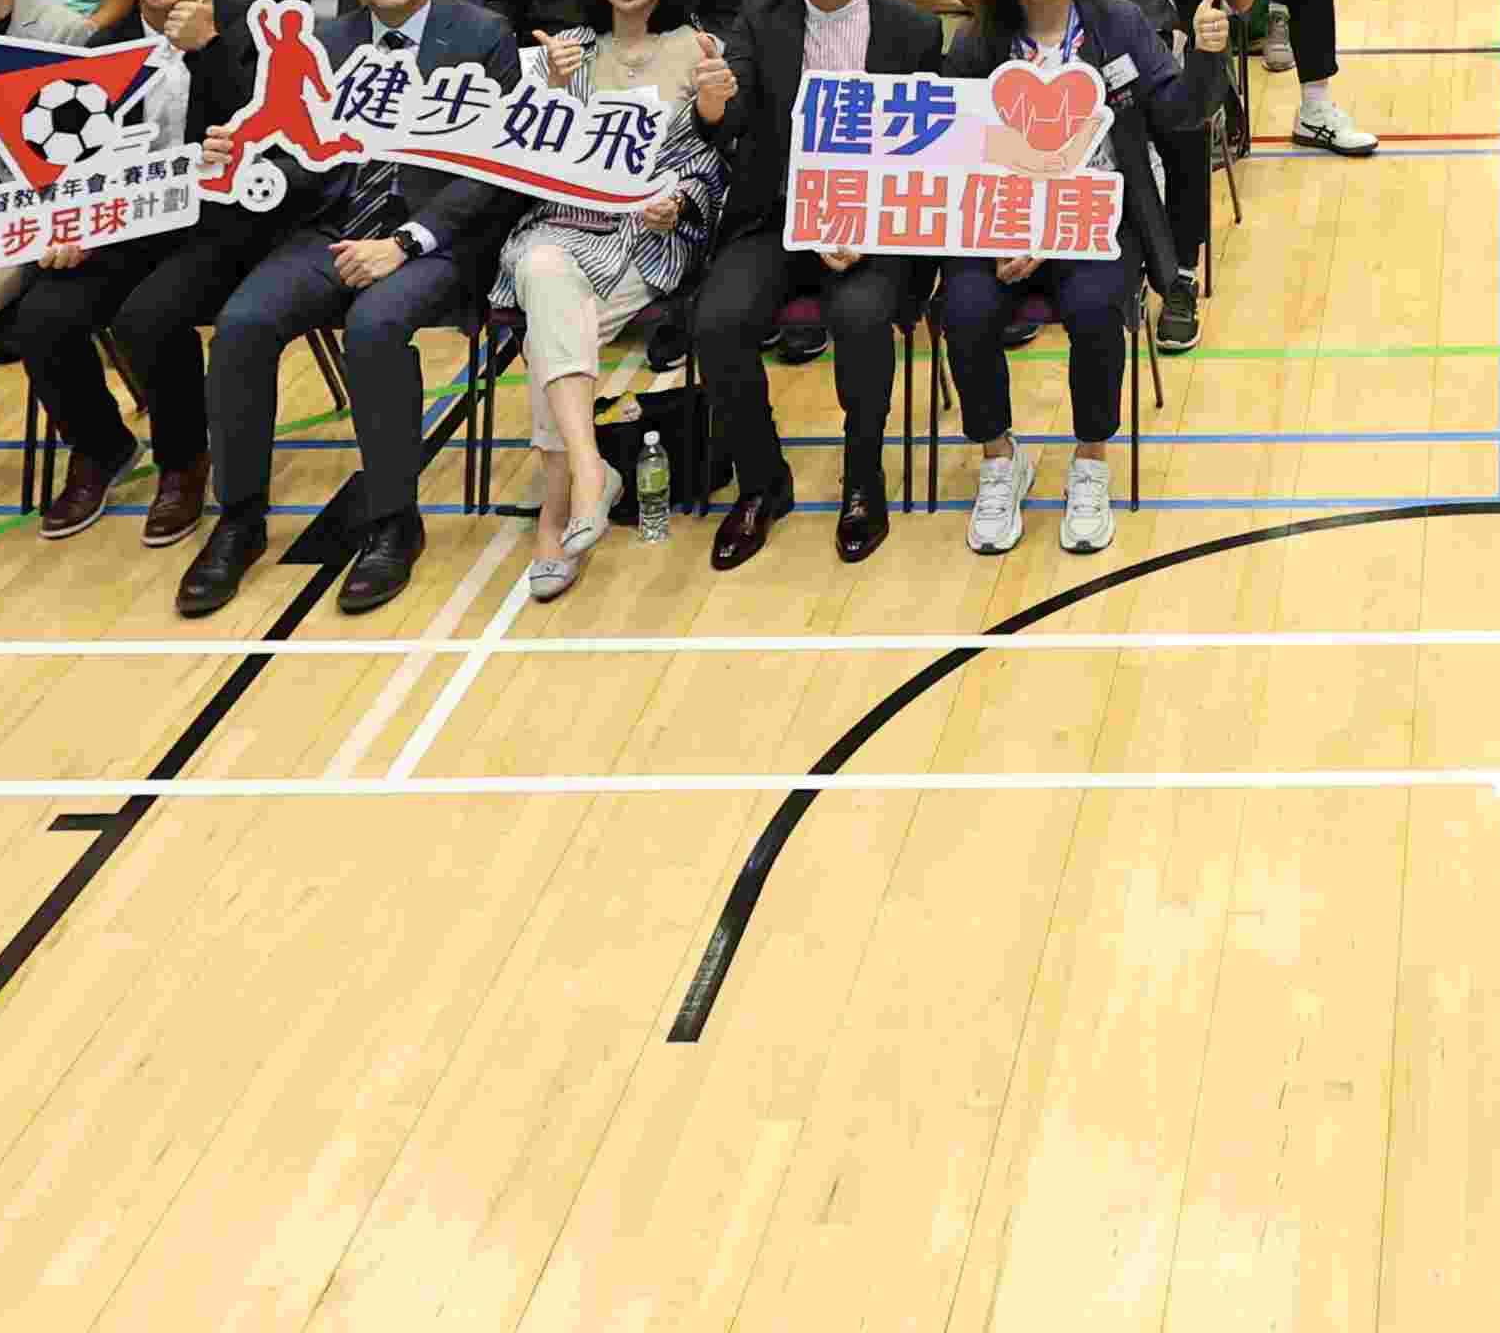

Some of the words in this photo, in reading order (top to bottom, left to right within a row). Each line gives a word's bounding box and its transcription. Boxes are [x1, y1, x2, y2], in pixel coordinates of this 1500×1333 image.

[331, 55, 663, 176] 健步如飛
[801, 77, 957, 156] 健步
[792, 168, 1117, 252] 踢出健康
